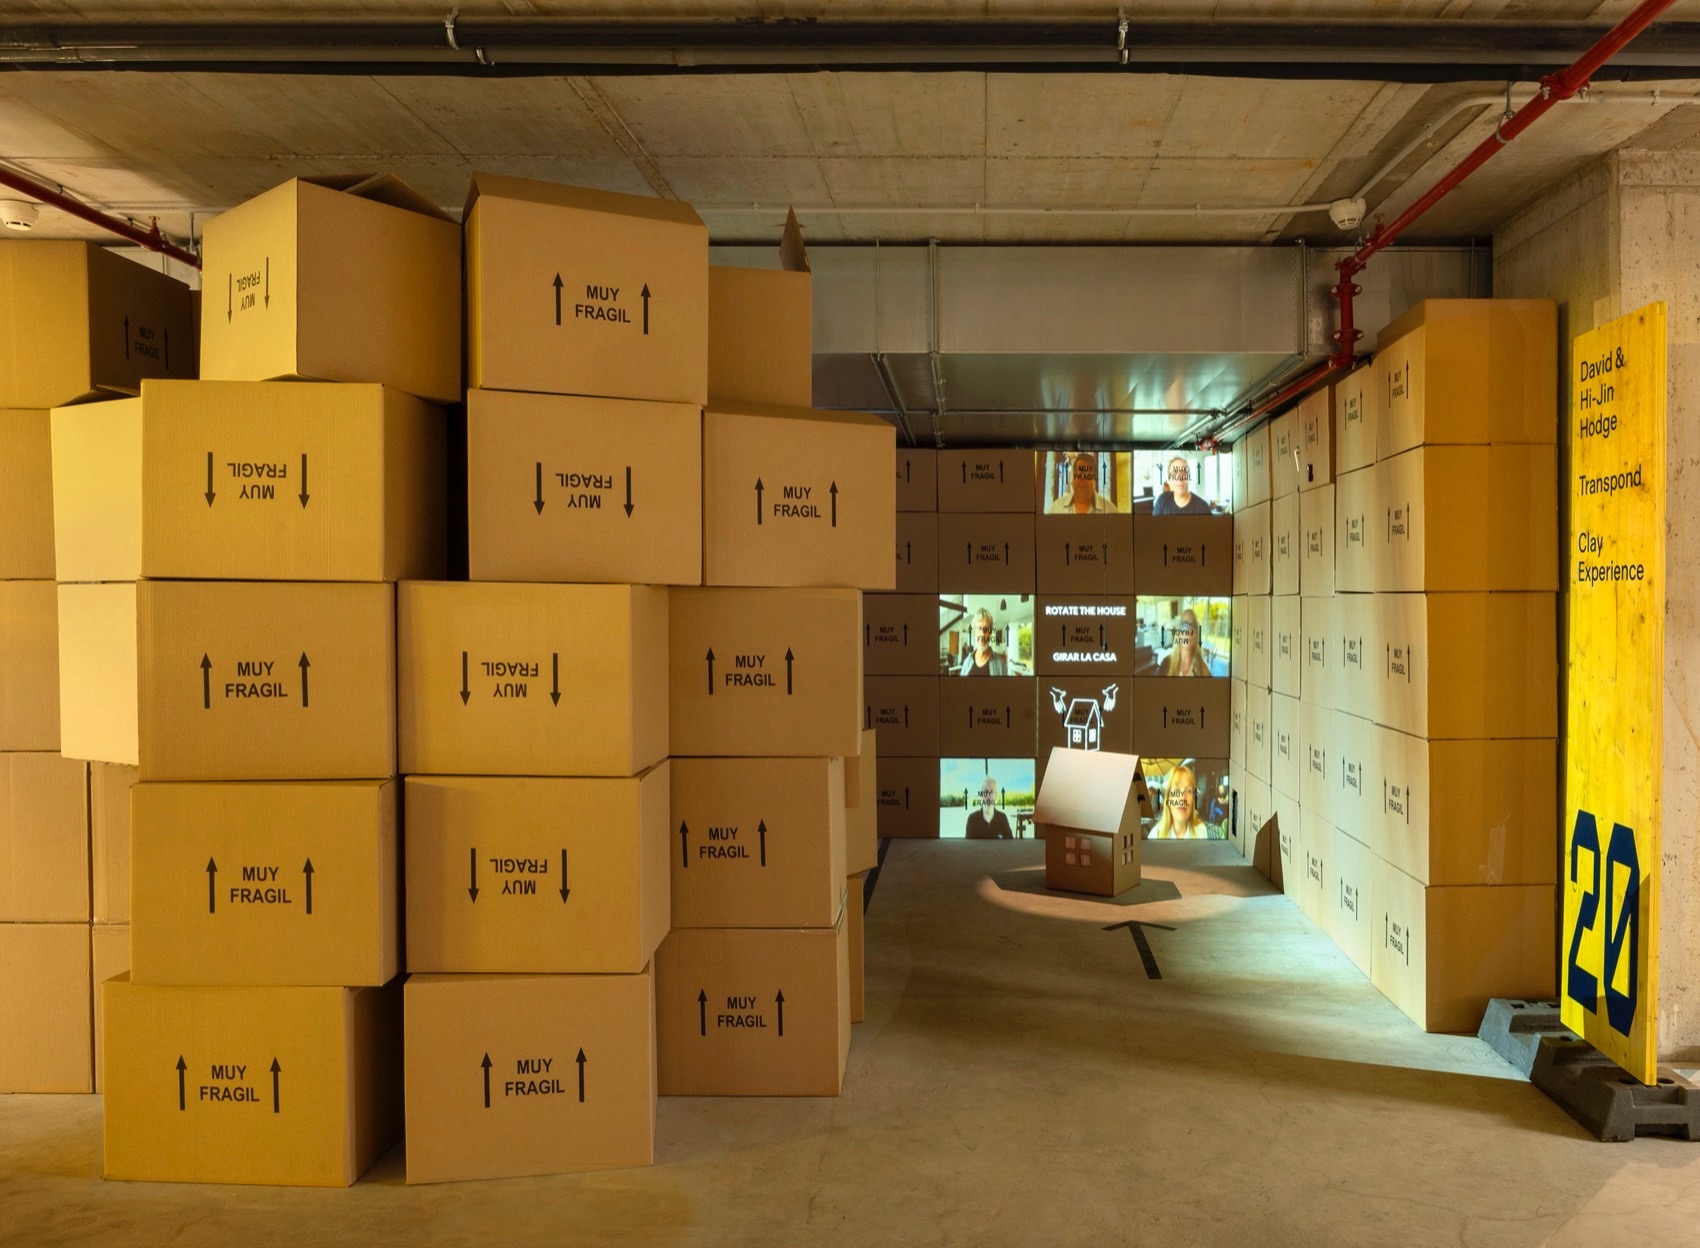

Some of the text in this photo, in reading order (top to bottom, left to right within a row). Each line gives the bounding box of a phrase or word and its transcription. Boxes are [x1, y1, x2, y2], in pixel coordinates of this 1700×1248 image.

[236, 270, 261, 293] FRAGIL
[586, 285, 620, 302] MUY
[240, 293, 256, 311] MUY
[575, 304, 631, 324] FRAGIL
[139, 326, 155, 340] MUY
[134, 340, 160, 360] FRAGIL
[1580, 346, 1625, 382] David &
[1392, 384, 1404, 397] FRAGIL
[1580, 383, 1614, 411] Hi-Jin
[1579, 413, 1618, 440] Hodge
[227, 462, 287, 478] FRAGIL
[971, 472, 995, 480] FRAGIL
[555, 473, 612, 489] FRAGIL
[1579, 464, 1642, 496] Transpond
[239, 484, 274, 499] MUY
[783, 486, 811, 500] MUY
[567, 494, 601, 509] MUY
[773, 504, 821, 519] FRAGIL
[1392, 522, 1405, 535] FRAGIL
[1578, 531, 1604, 557] Clay
[1172, 555, 1197, 563] FRAGIL
[1578, 561, 1644, 587] Experience
[1046, 607, 1126, 615] ROTATE THE HOUSE
[874, 635, 899, 643] FRAGIL
[735, 655, 766, 668] MUY
[1053, 653, 1117, 661] GIRAR LA CASA
[237, 661, 274, 676] MUY
[481, 661, 539, 677] FRAGIL
[1391, 662, 1405, 675] FRAGIL
[725, 672, 776, 687] FRAGIL
[225, 682, 288, 698] FRAGIL
[493, 683, 527, 698] MUY
[977, 717, 1002, 725] FRAGIL
[1070, 717, 1094, 725] FRAGL
[1172, 717, 1196, 725] FRAGIL
[1389, 798, 1403, 815] FRAGIL
[708, 828, 738, 841] MUY
[699, 845, 749, 859] FRAGIL
[490, 858, 547, 873] FRAGIL
[242, 867, 279, 882] MUY
[502, 879, 536, 894] MUY
[230, 888, 292, 903] FRAGIL
[1567, 808, 1640, 1038] 20
[1389, 935, 1404, 954] FRAGIL
[727, 997, 757, 1010] MUY
[717, 1014, 767, 1028] FRAGIL
[211, 1065, 247, 1080] MUY
[517, 1059, 553, 1075] MUY
[200, 1086, 260, 1102] FRAGIL
[505, 1080, 565, 1097] FRAGIL
